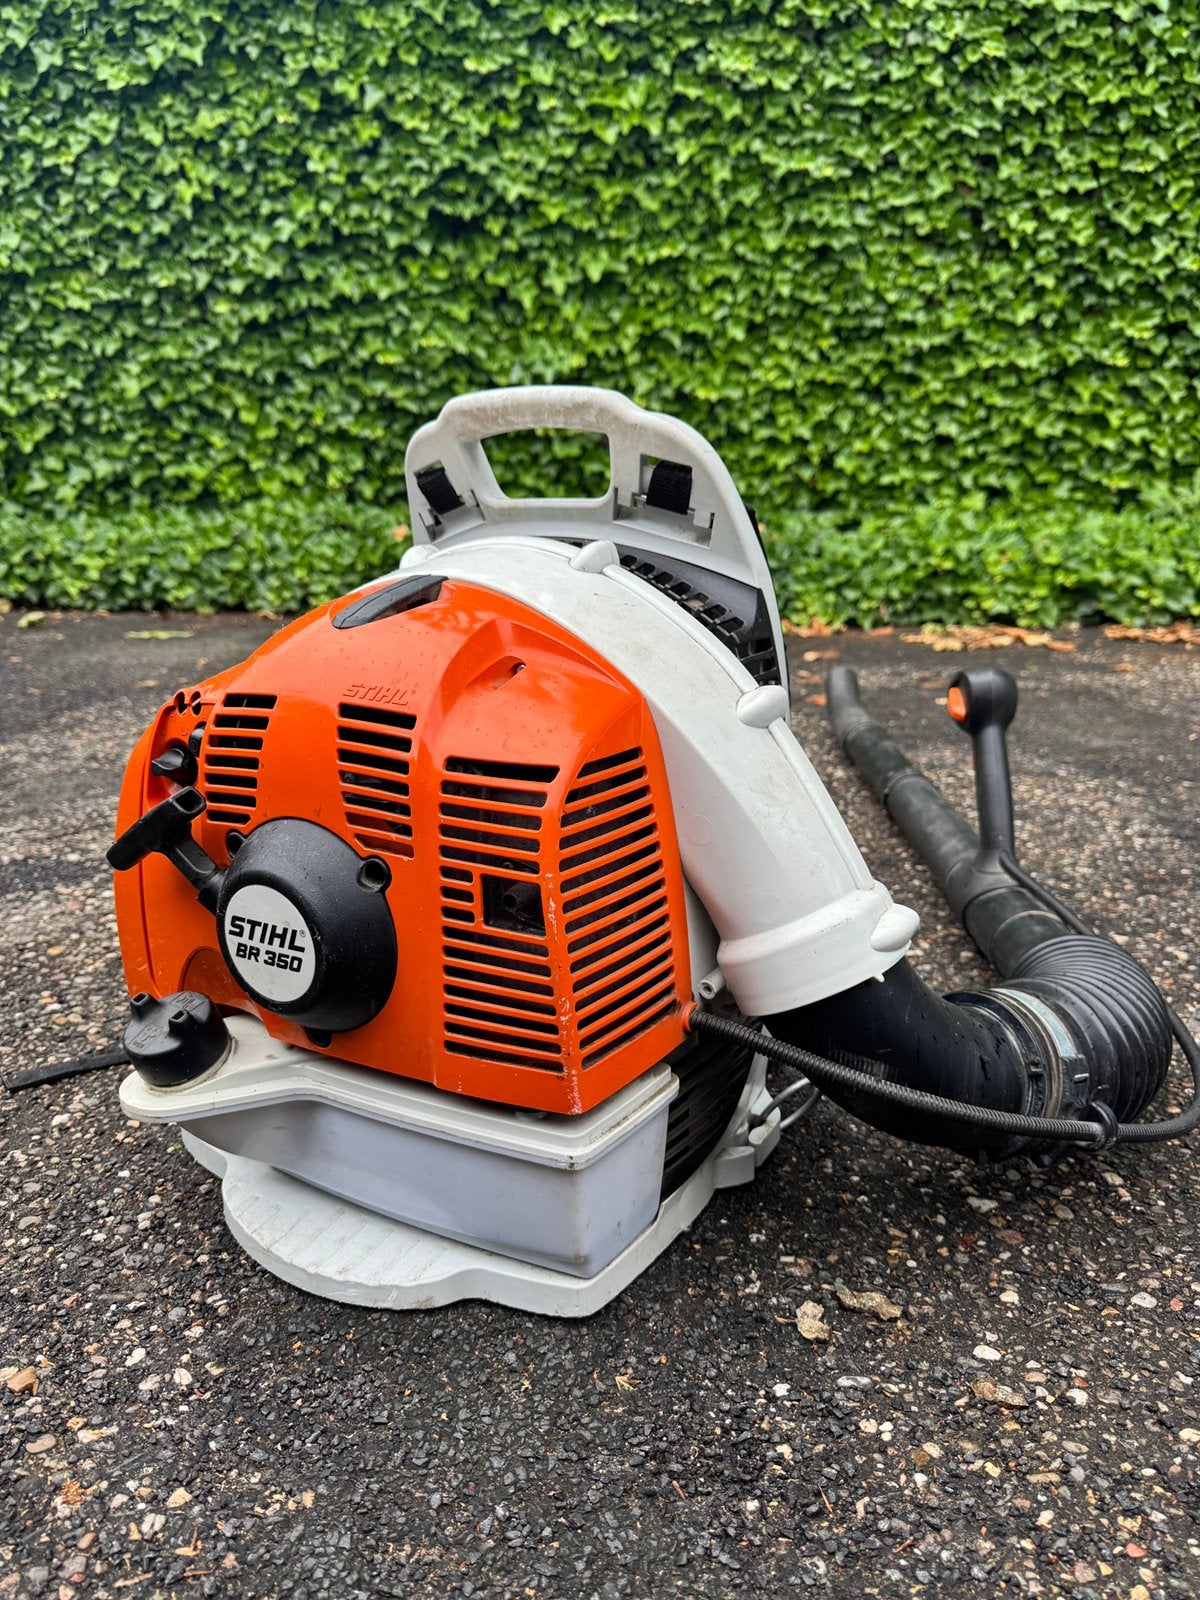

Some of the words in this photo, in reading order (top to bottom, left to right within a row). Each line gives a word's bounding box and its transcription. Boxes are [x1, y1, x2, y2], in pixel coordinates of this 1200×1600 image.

[341, 683, 409, 706] STIHL
[236, 942, 260, 963] BR
[263, 949, 303, 972] 350
